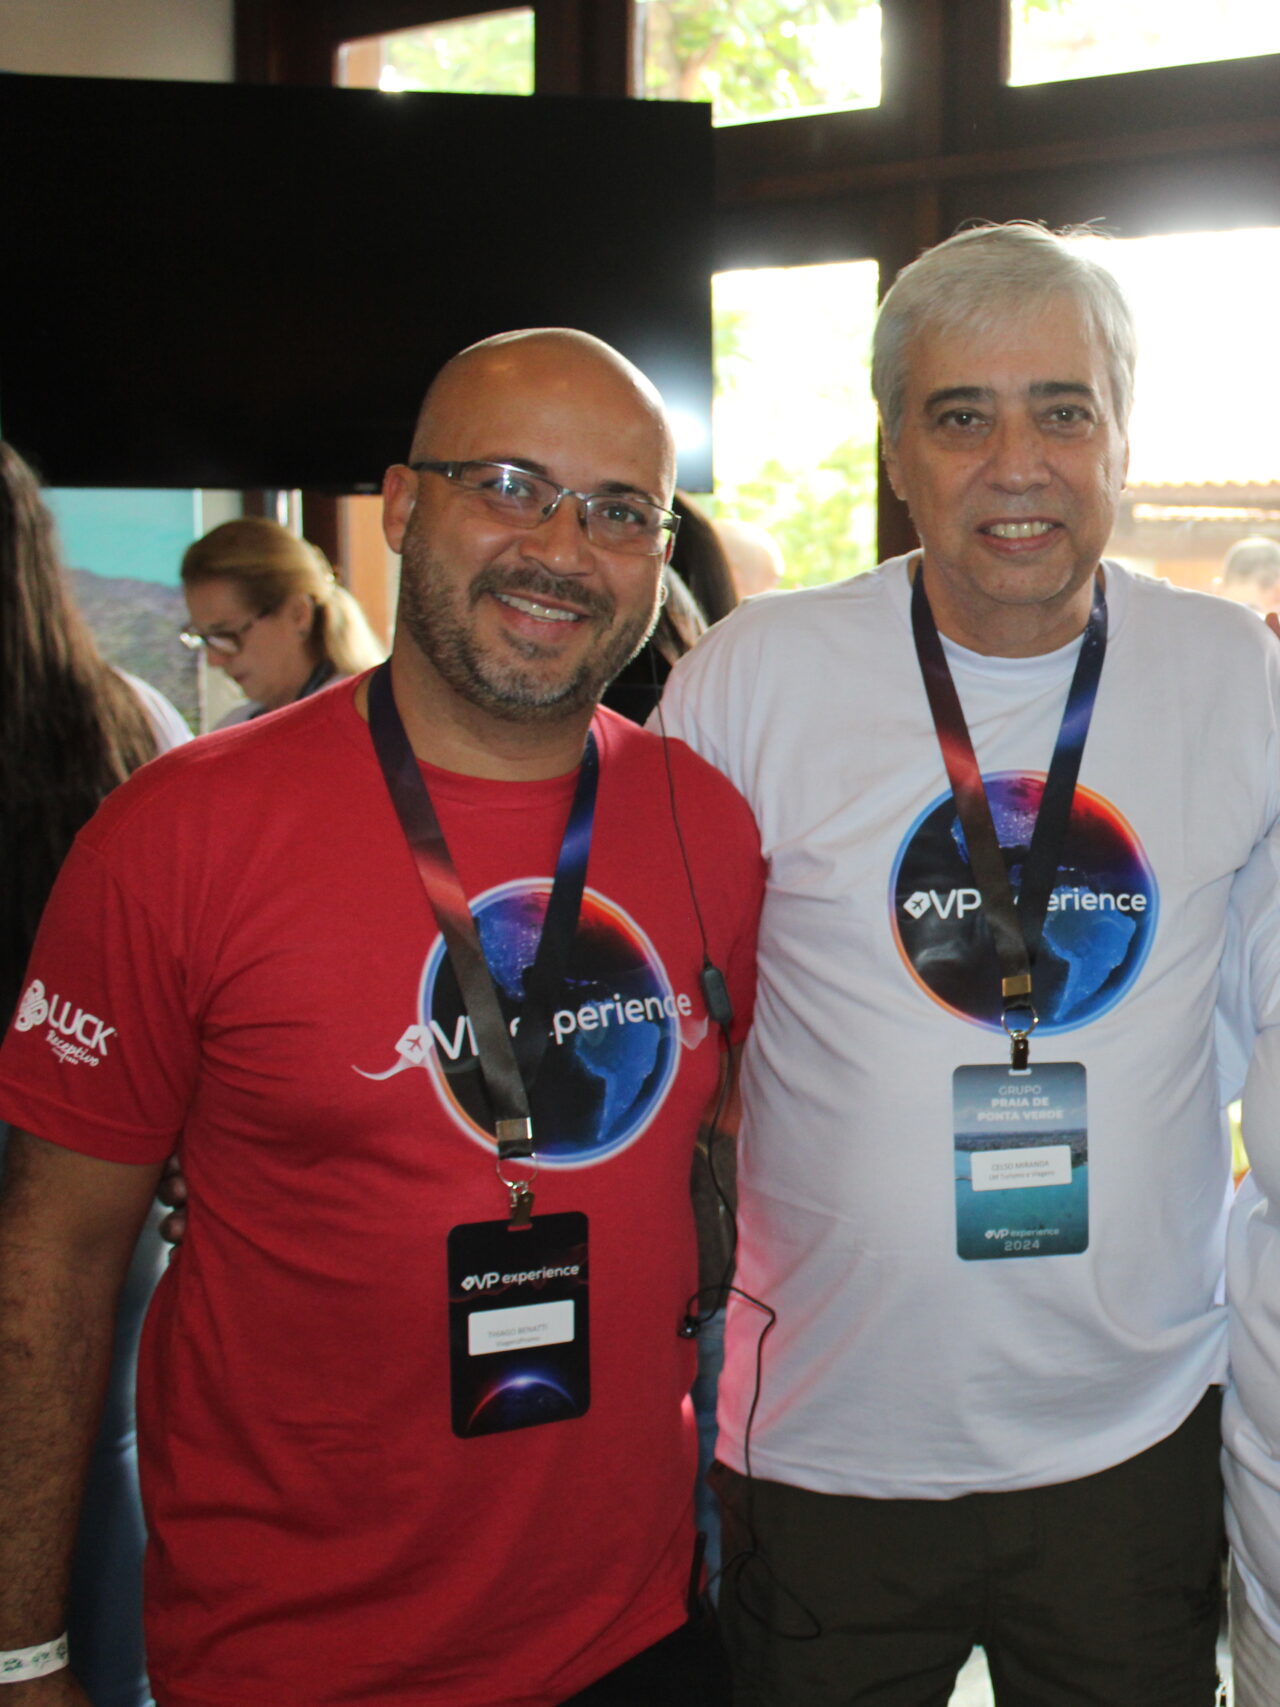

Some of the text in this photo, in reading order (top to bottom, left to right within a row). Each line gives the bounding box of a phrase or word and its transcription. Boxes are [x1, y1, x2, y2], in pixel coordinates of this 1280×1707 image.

[929, 887, 1147, 919] VP erience
[48, 993, 116, 1056] LUCK
[511, 993, 692, 1046] perience
[998, 1084, 1041, 1096] GRUPO
[991, 1096, 1050, 1108] PRAIA DE
[977, 1109, 1064, 1122] PONTA VERDE
[1010, 1228, 1060, 1238] experience
[1004, 1239, 1041, 1252] 2024
[475, 1265, 580, 1290] VP experience
